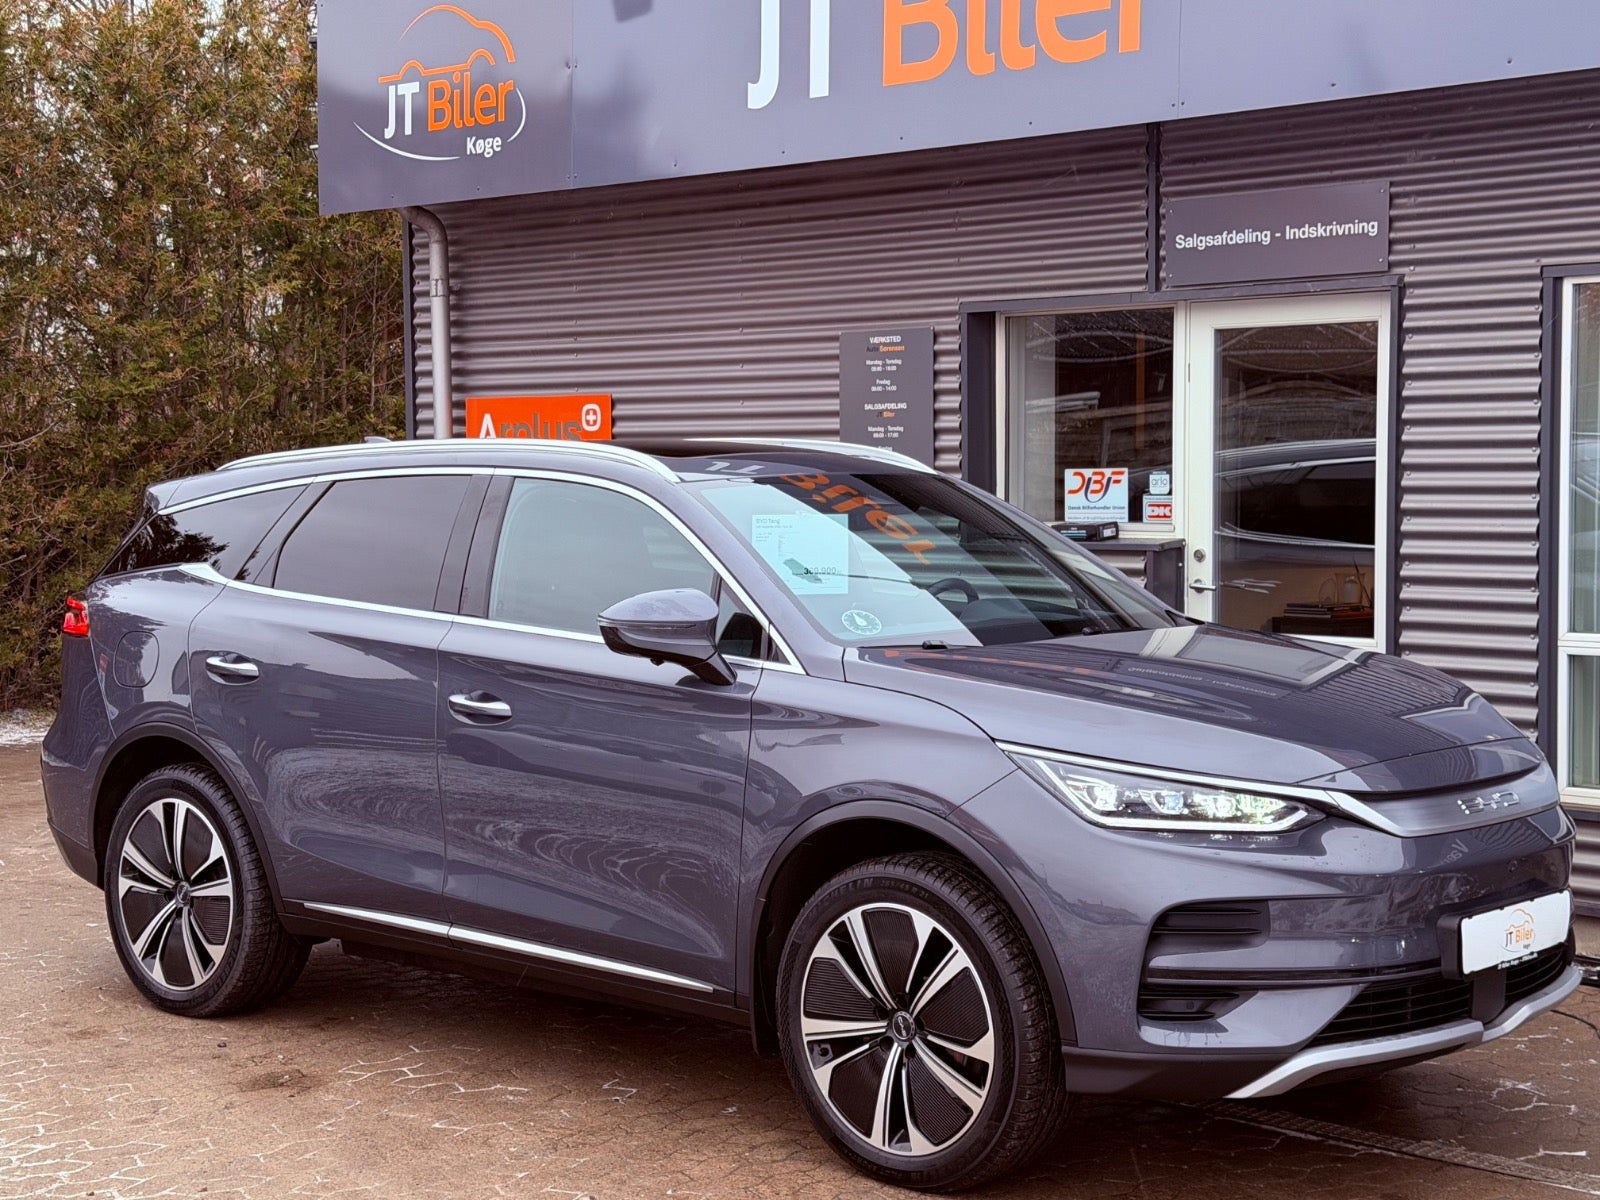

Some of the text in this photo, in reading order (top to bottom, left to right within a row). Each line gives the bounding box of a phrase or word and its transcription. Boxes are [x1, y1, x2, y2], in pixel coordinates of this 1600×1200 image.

[384, 71, 514, 139] JT Biler
[466, 136, 502, 158] Køge
[1175, 228, 1271, 250] Salgsafdeling
[1285, 219, 1378, 240] Indskrivning
[869, 335, 902, 344] VÆRKSTED
[1515, 928, 1534, 944] Biler
